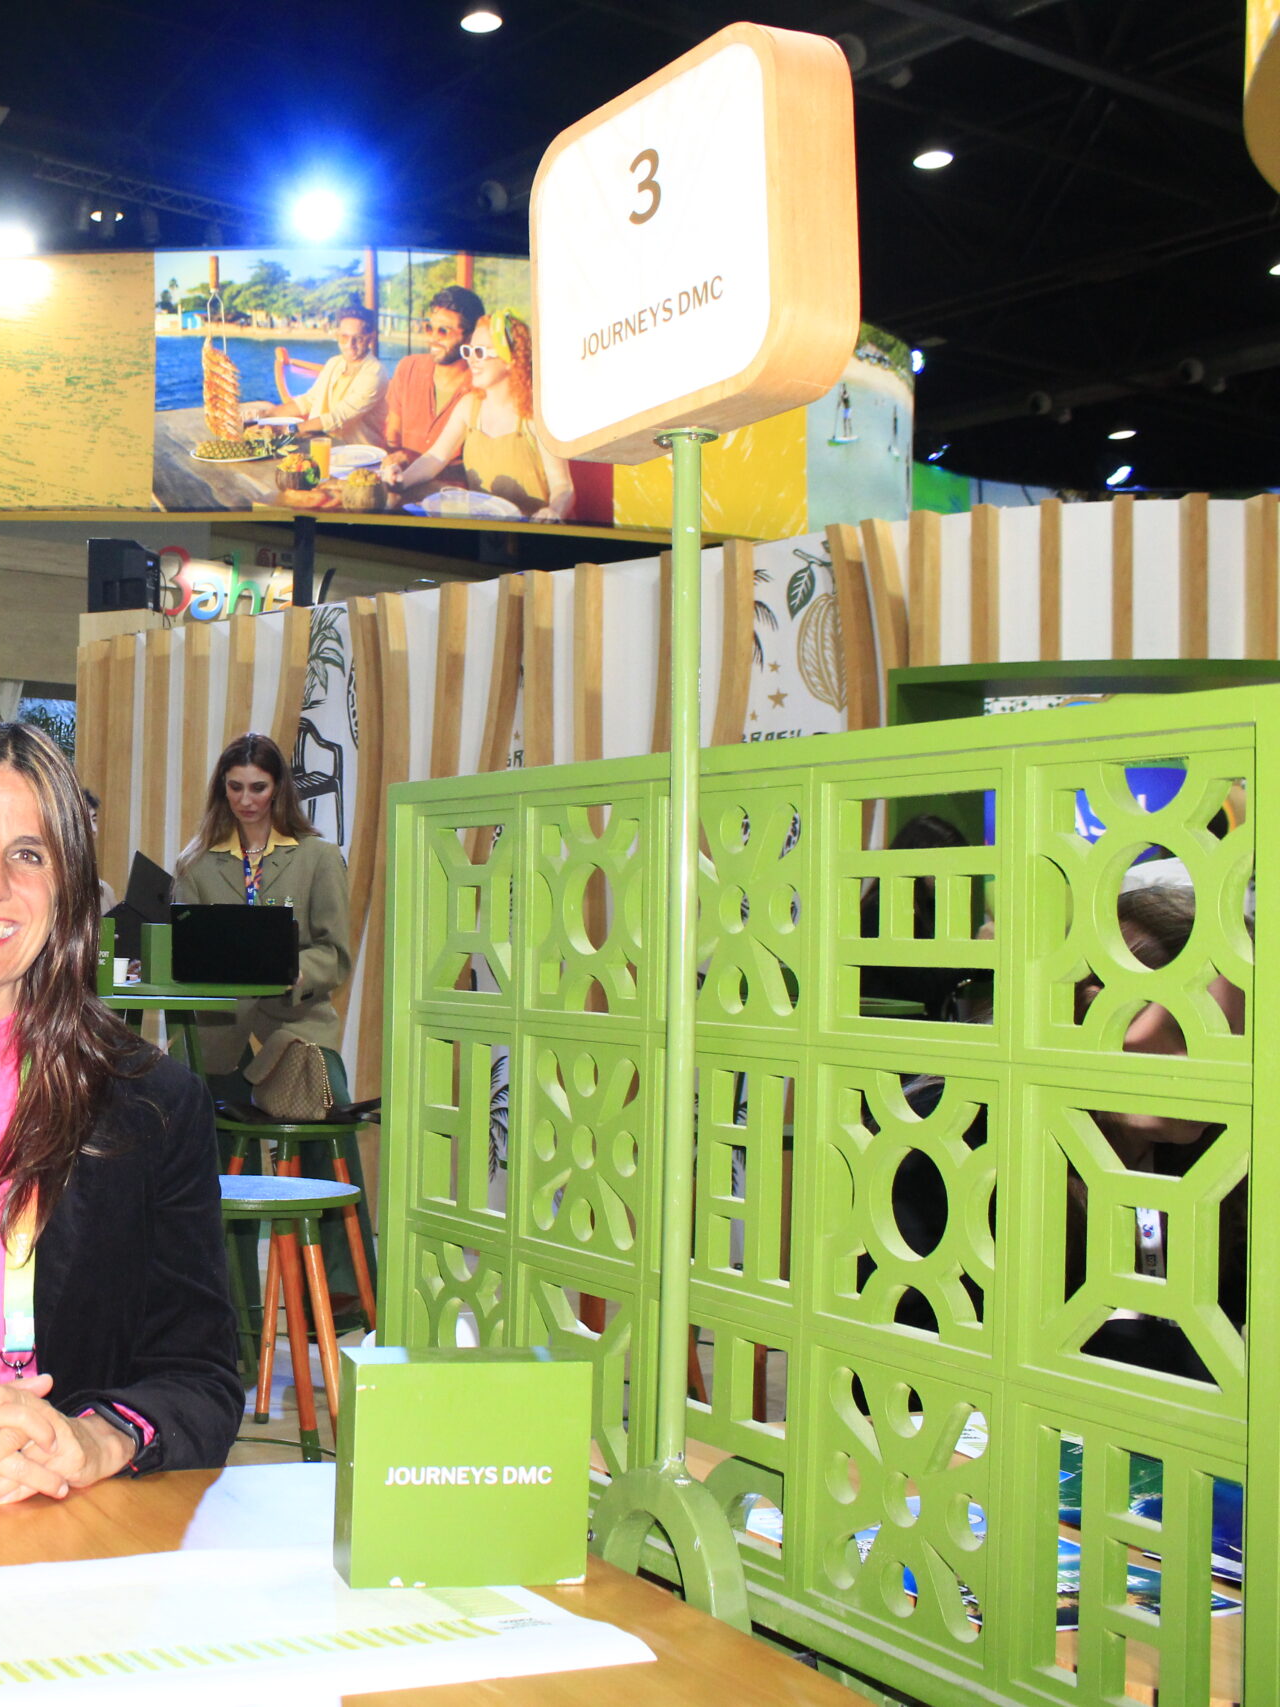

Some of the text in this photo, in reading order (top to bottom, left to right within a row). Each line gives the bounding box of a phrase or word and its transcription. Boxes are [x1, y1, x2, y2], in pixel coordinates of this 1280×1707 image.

[629, 148, 661, 225] 3
[581, 275, 723, 360] JOURNEYS DMC
[385, 1466, 553, 1486] JOURNEYS DMC
